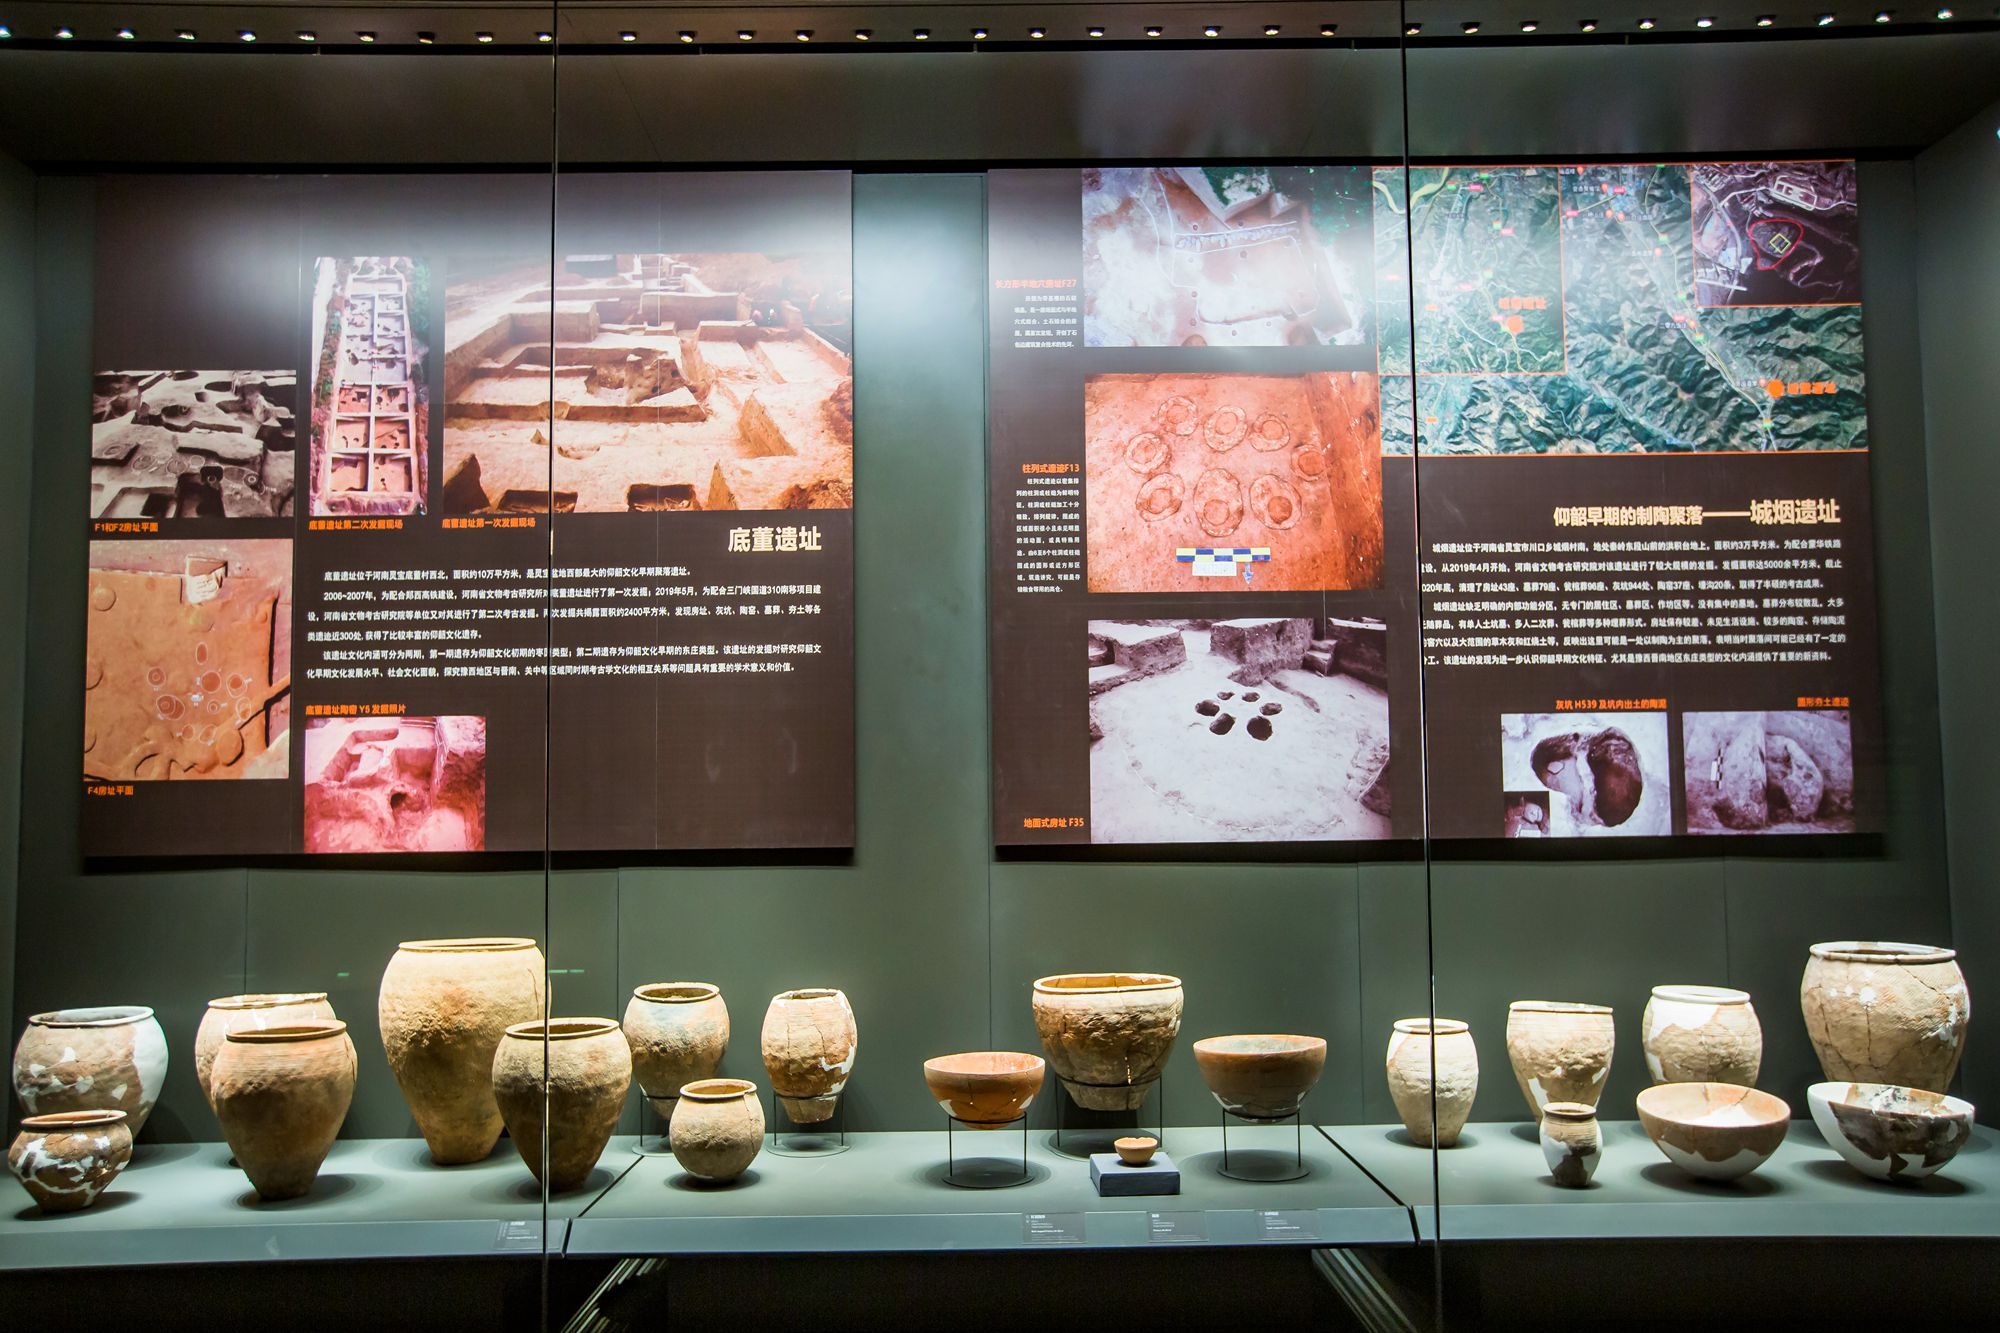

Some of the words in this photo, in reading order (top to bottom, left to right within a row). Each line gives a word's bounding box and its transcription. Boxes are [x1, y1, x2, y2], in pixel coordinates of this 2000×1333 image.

[728, 525, 822, 552] 底董遗址
[1575, 700, 1597, 709] H539
[1069, 818, 1084, 827] F35
